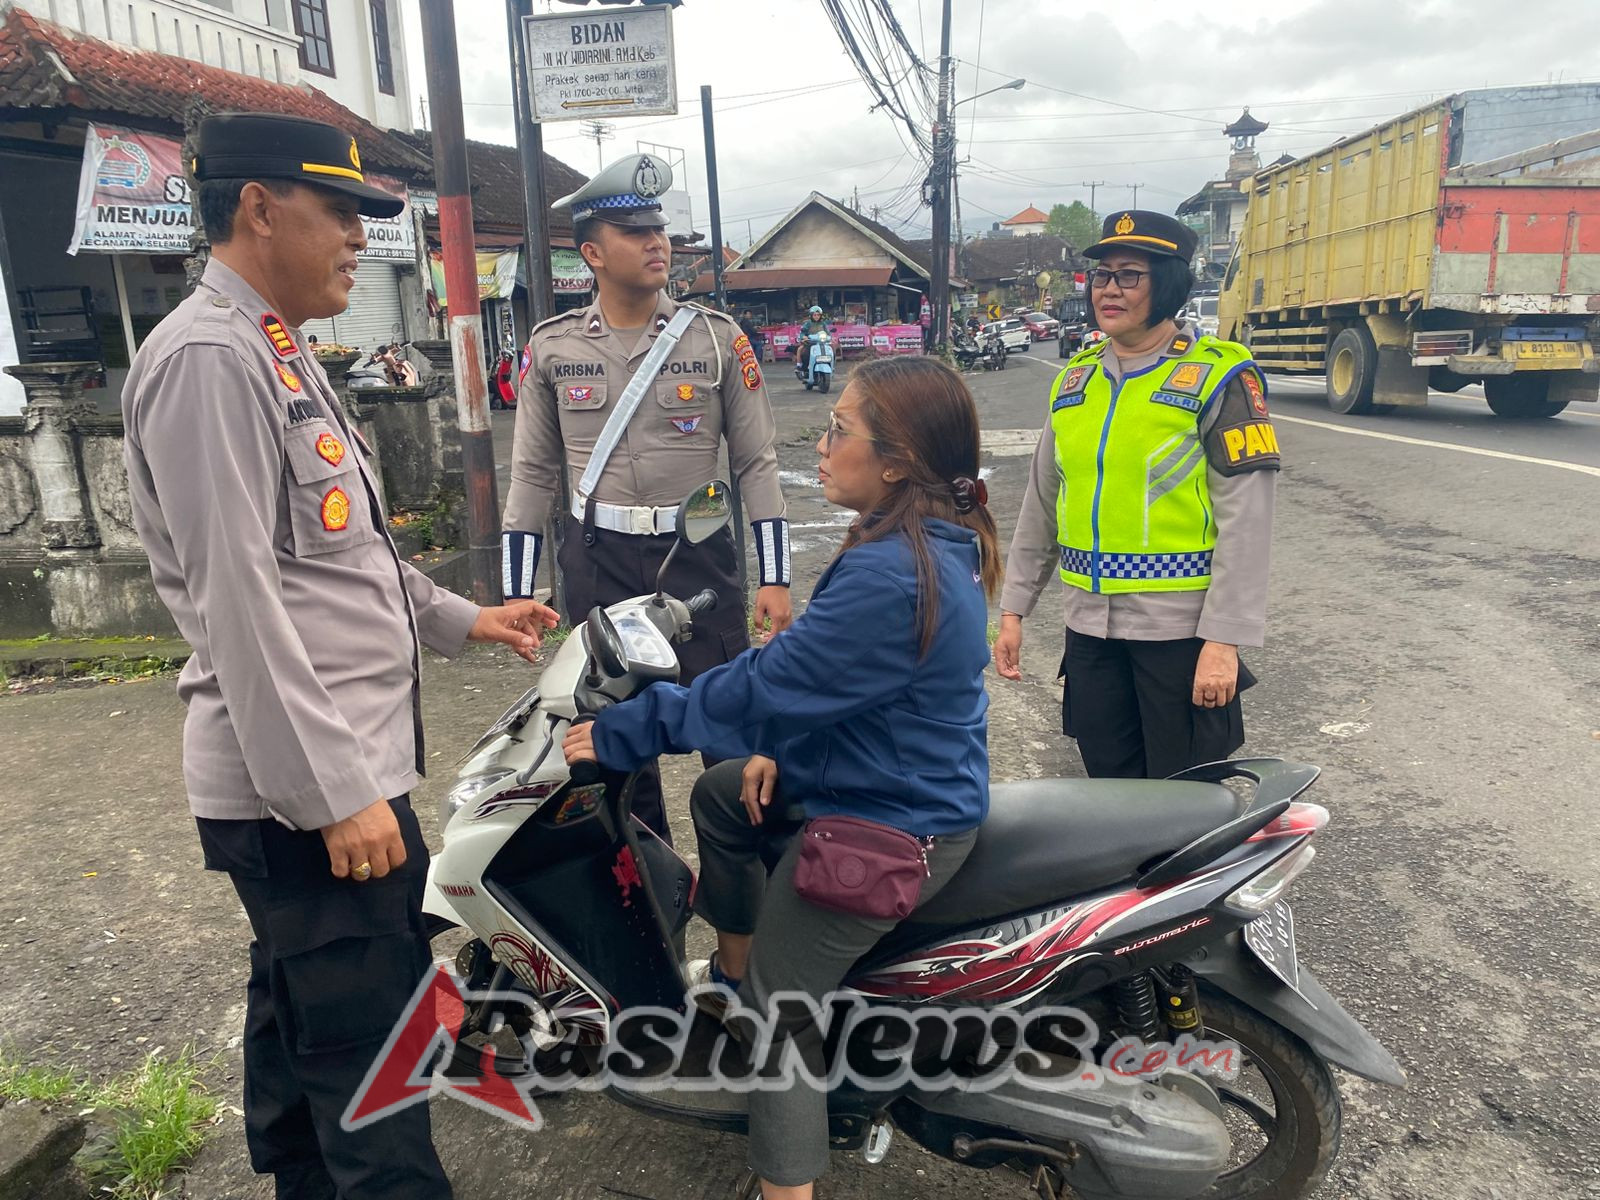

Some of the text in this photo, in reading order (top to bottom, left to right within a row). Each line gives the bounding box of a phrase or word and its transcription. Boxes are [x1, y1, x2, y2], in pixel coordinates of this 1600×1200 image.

[570, 22, 626, 45] BIDAN
[96, 206, 191, 227] MENJUA
[94, 230, 136, 239] ALAMAT
[145, 232, 174, 240] JALAN
[367, 227, 403, 242] AQUA
[80, 238, 143, 247] ECAMATAN
[554, 362, 605, 378] KRISNA
[659, 361, 708, 376] POLRI
[1154, 393, 1197, 409] POLRI
[441, 884, 477, 897] YAMAHA
